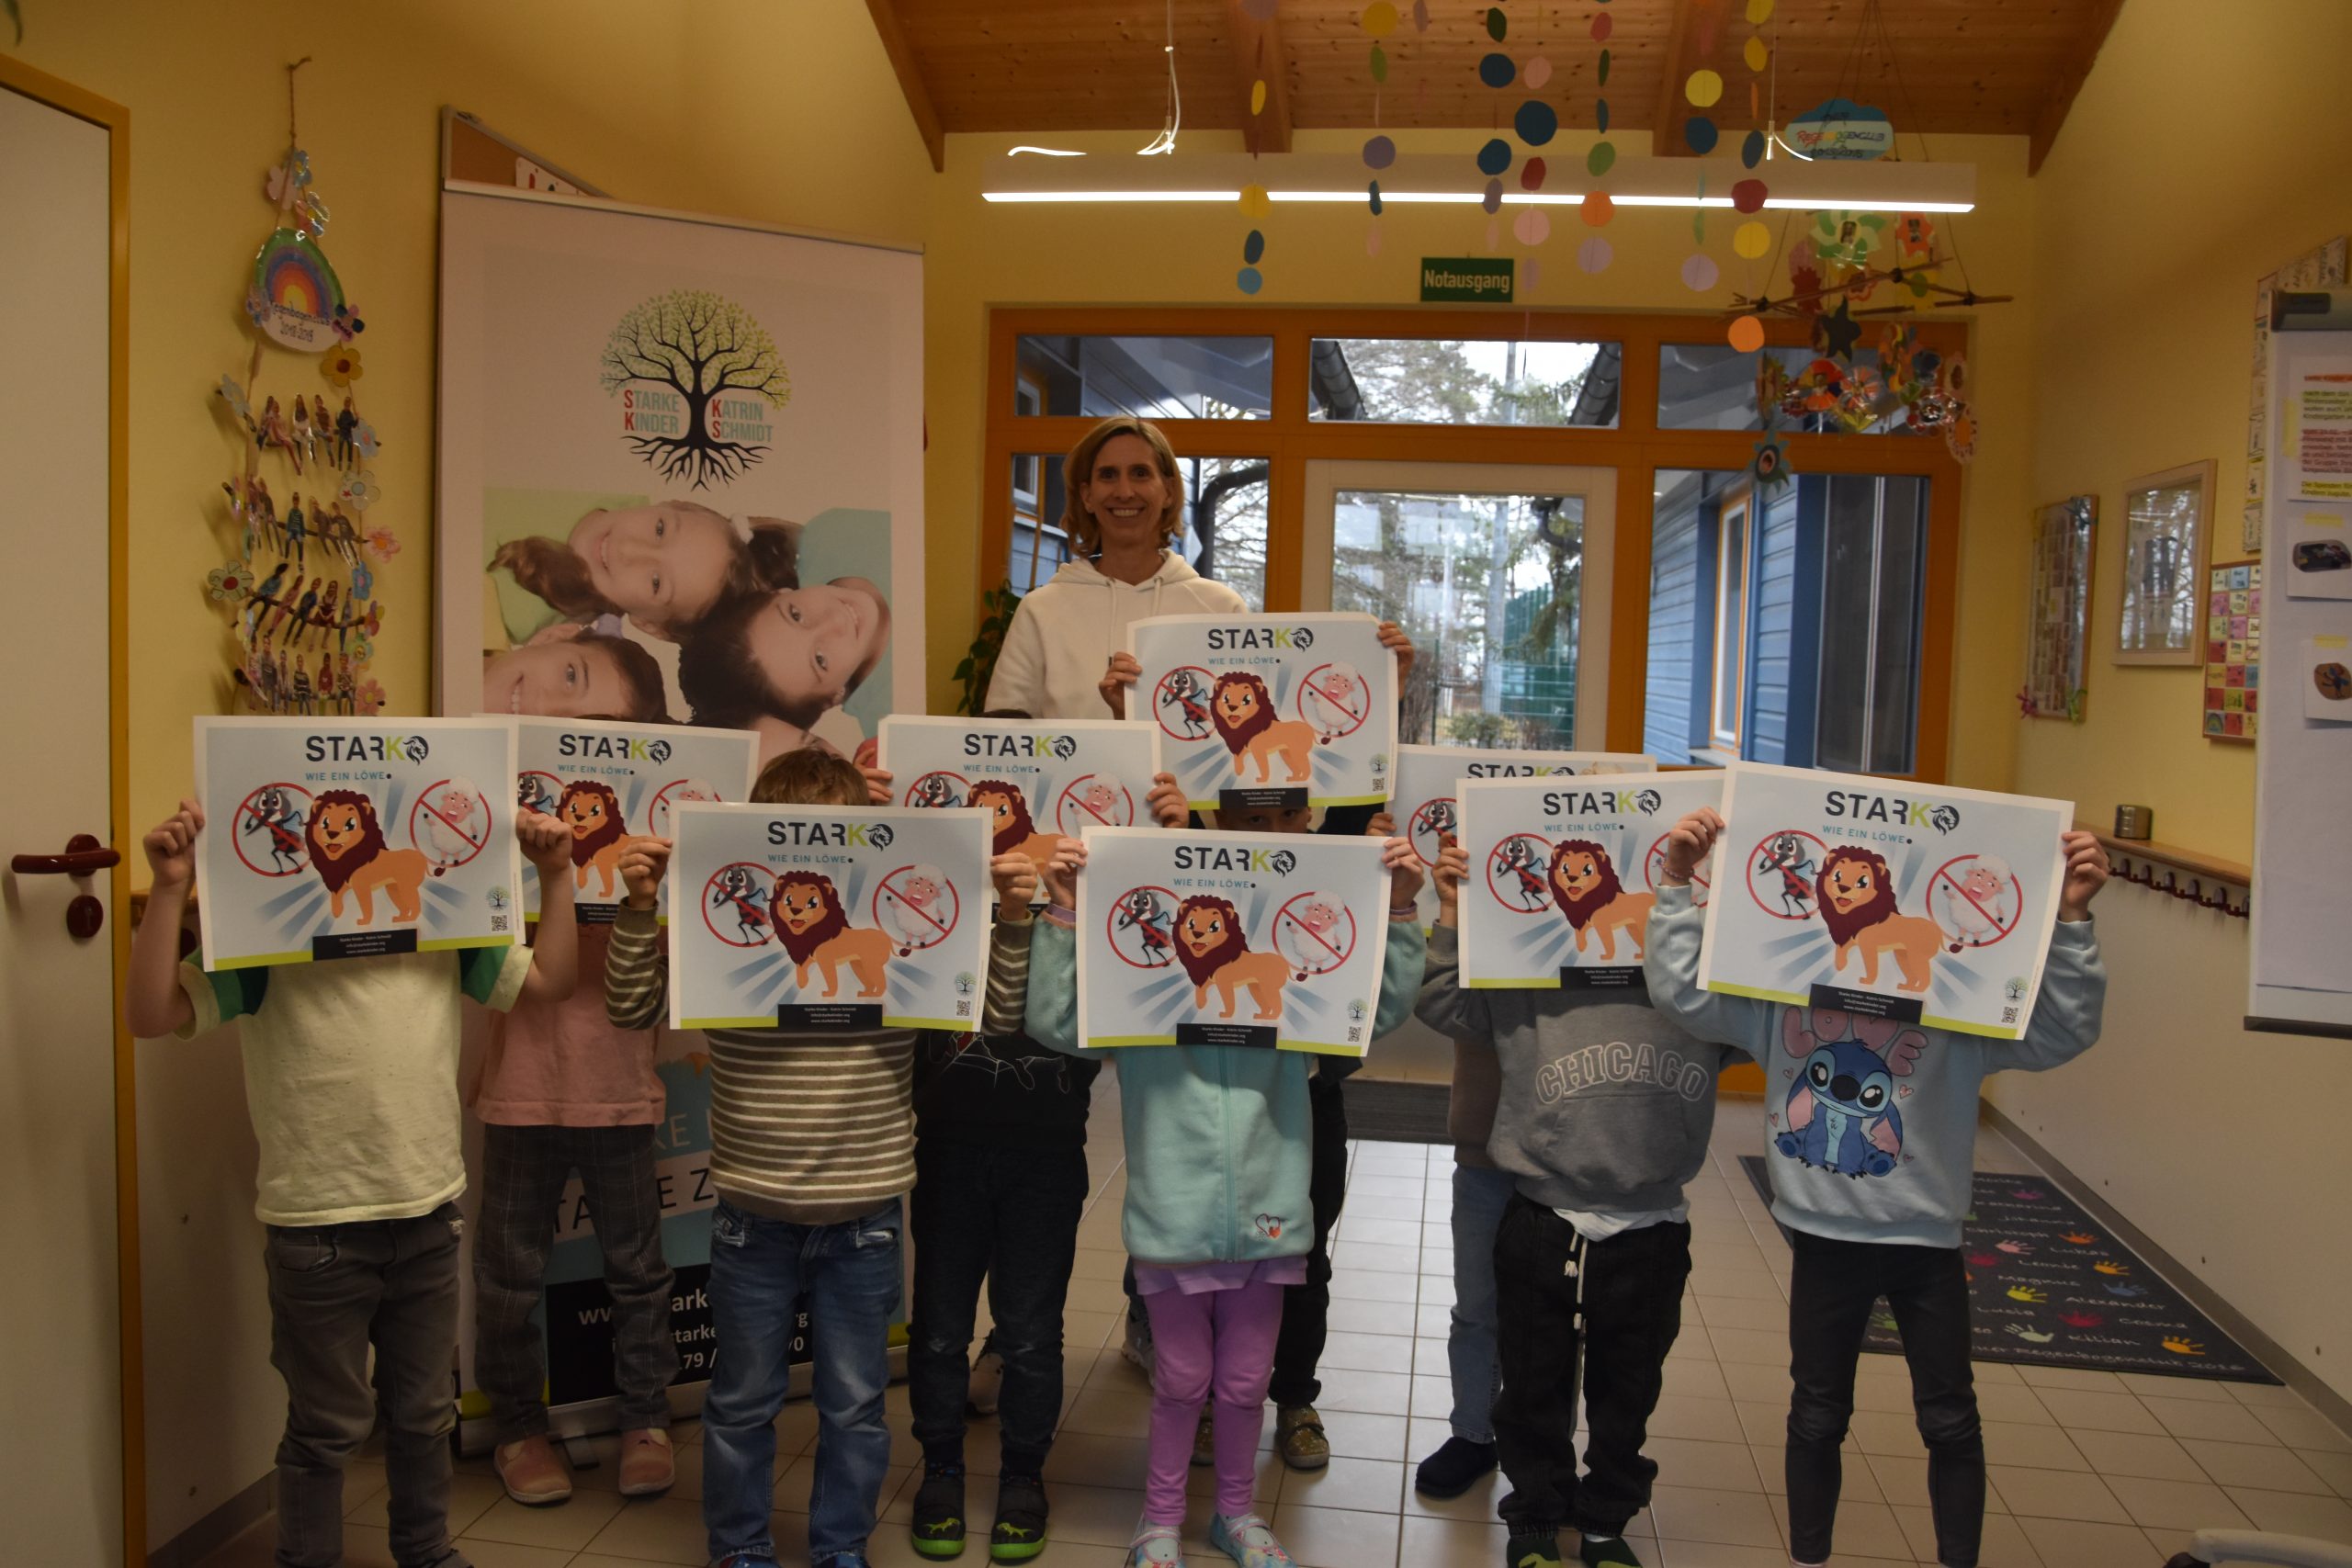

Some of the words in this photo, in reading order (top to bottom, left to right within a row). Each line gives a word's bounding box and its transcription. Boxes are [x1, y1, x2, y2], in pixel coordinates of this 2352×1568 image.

[1424, 269, 1510, 294] Notausgang
[624, 389, 680, 412] STARKE
[712, 399, 763, 422] KATRIN
[625, 411, 679, 434] KINDER
[712, 420, 774, 443] SCHMIDT
[1208, 628, 1293, 649] STARK
[306, 736, 405, 761] STARK
[559, 734, 649, 761] STARK
[964, 733, 1054, 757] STARK
[305, 773, 325, 781] WIE
[558, 764, 575, 773] WIE
[581, 765, 596, 773] EIN
[1544, 790, 1638, 815] STARK
[1825, 791, 1932, 829] STARK
[767, 821, 868, 847] STARK
[1544, 824, 1562, 832] WIE
[1567, 823, 1584, 831] EIN
[1823, 824, 1842, 835] WIE
[1849, 829, 1867, 838] EIN
[767, 854, 787, 863] WIE
[793, 854, 810, 863] EIN
[1174, 846, 1272, 872] STARK
[1782, 1006, 1928, 1077] LOVE
[1535, 1041, 1709, 1104] CHICAGO
[2064, 1296, 2166, 1310] Alexander
[2067, 1333, 2142, 1346] Kilian
